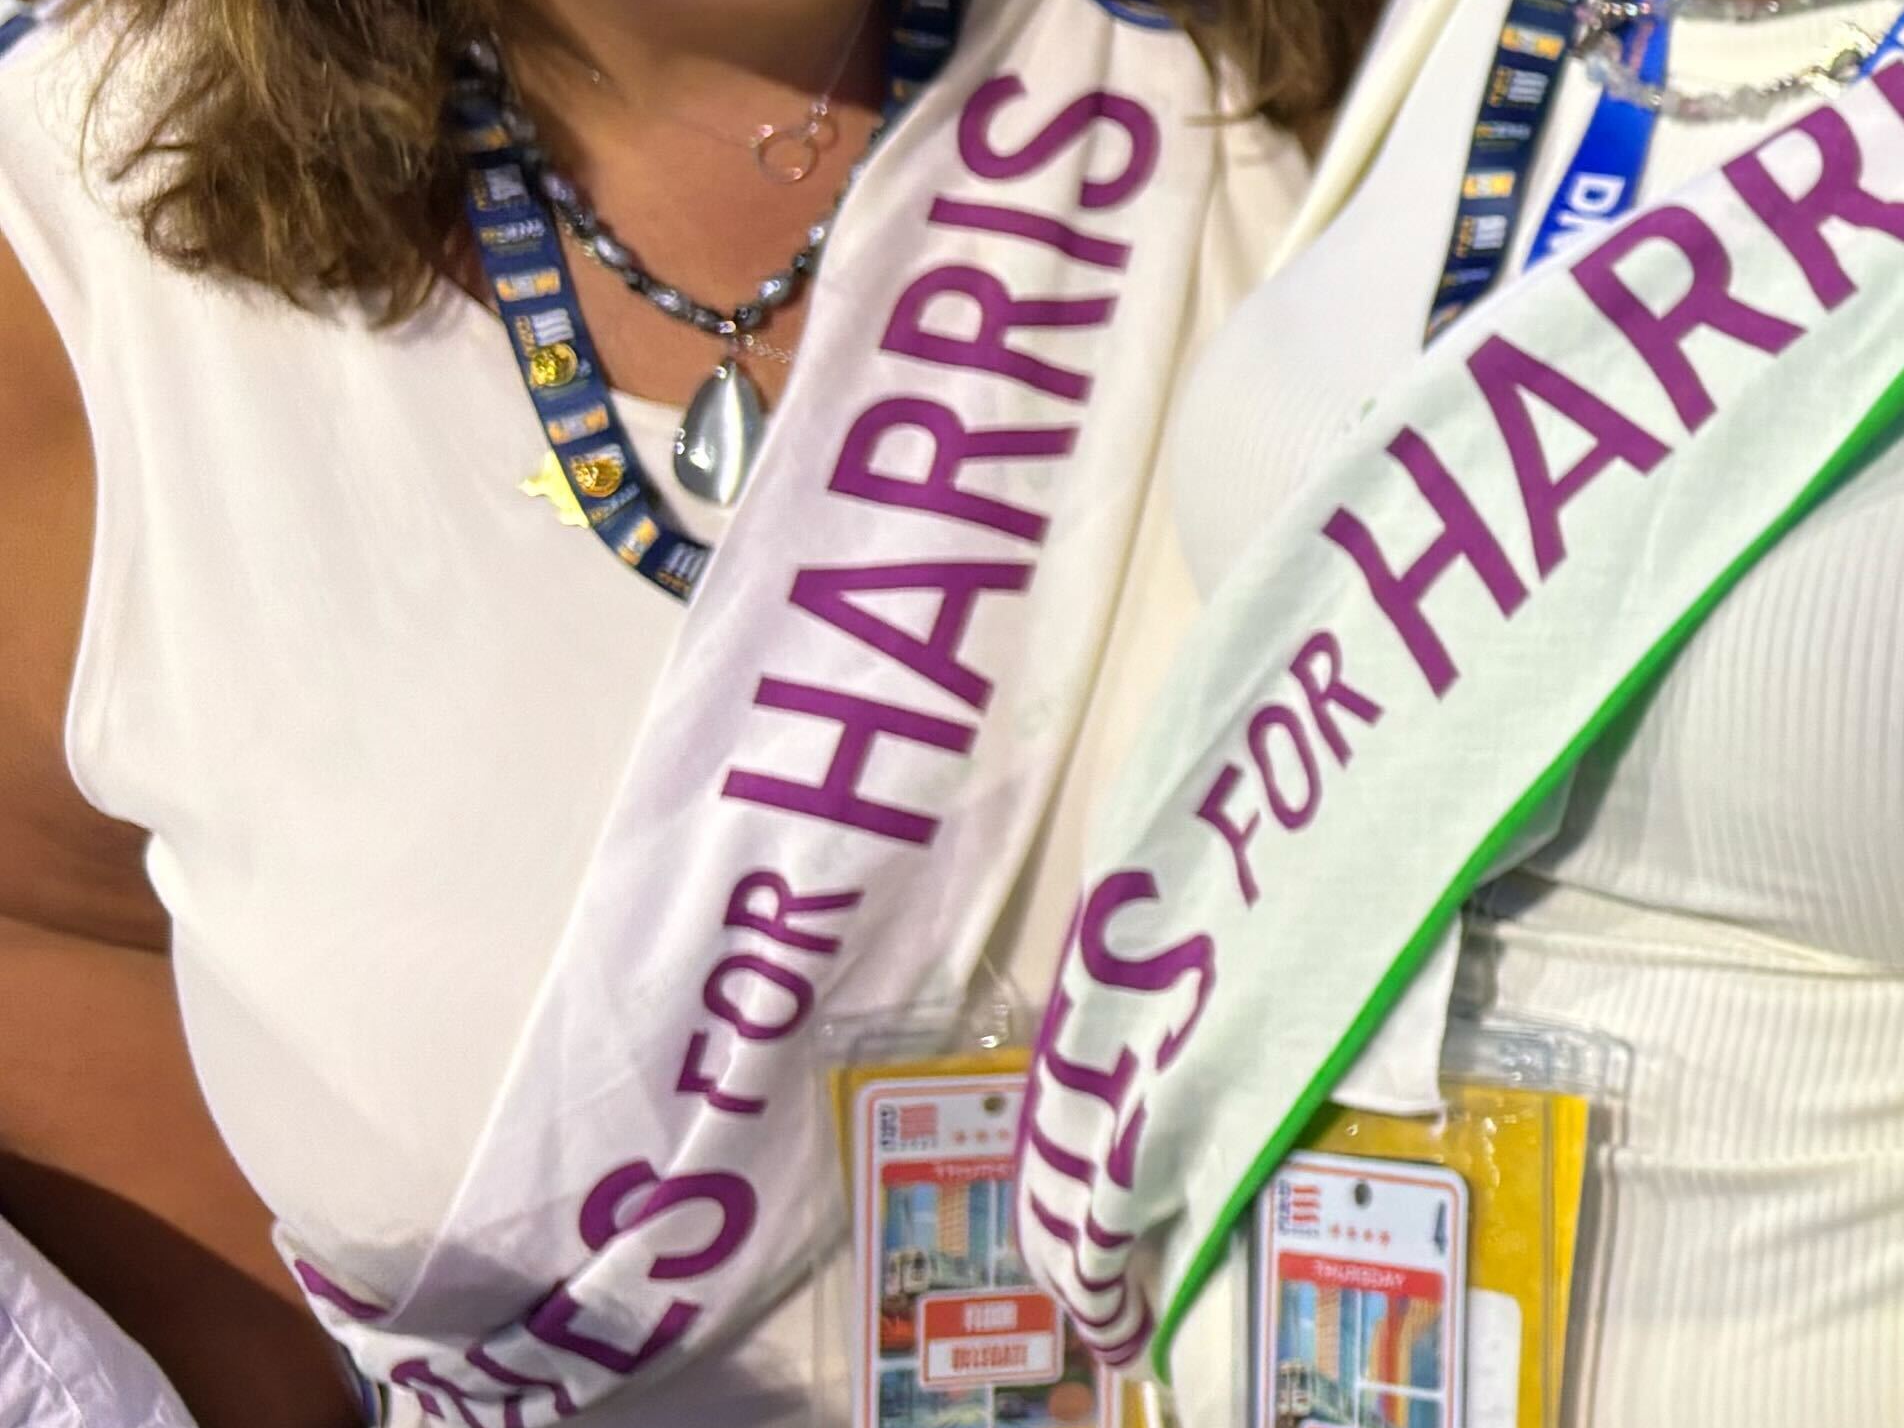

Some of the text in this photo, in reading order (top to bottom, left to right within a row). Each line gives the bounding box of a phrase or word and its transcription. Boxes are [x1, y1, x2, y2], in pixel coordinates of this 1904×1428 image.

[723, 76, 1155, 844] HARRIS
[1197, 632, 1384, 906] FOR
[677, 872, 859, 1113] FOR
